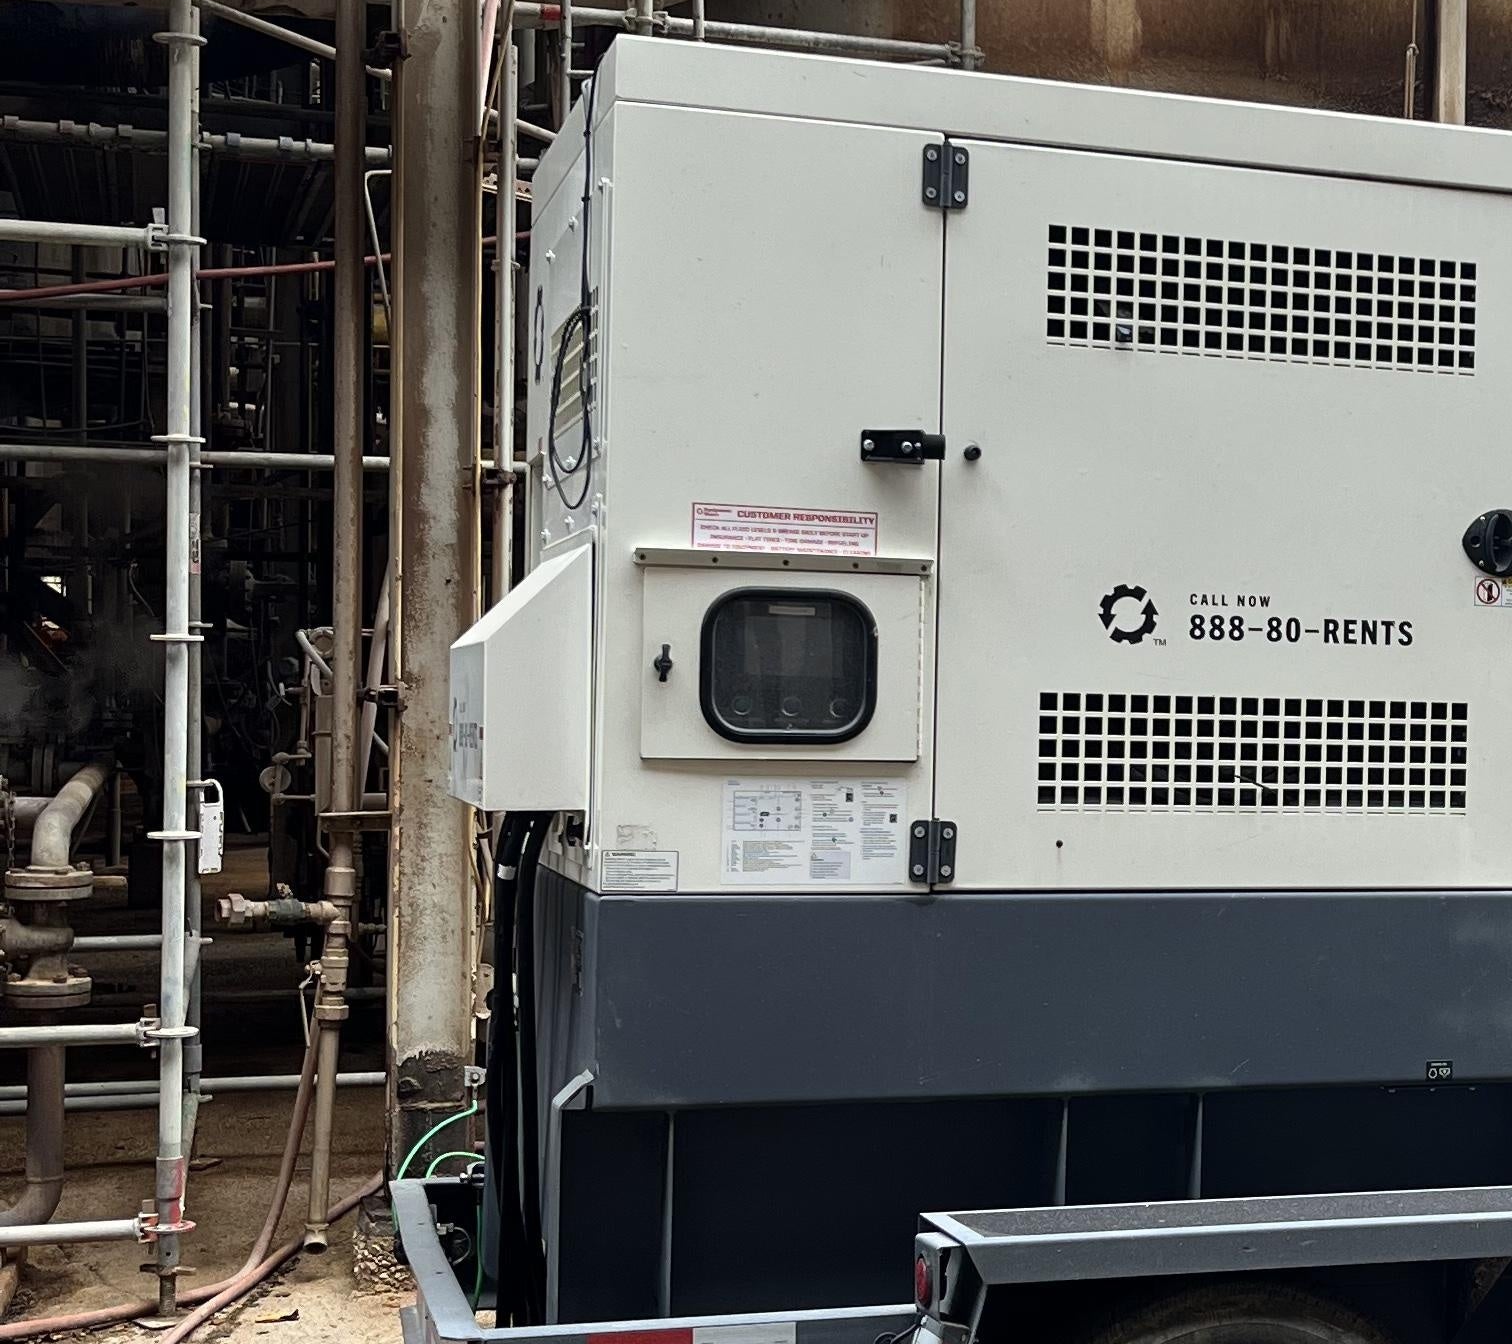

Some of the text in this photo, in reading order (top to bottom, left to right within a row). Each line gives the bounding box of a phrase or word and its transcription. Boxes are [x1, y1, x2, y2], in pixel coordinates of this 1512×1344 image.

[737, 510, 791, 521] CUSTOMER
[793, 513, 874, 525] RESPONSIBILITY
[1189, 593, 1271, 608] CALL NOW
[1189, 614, 1413, 647] 888-80-RENTS
